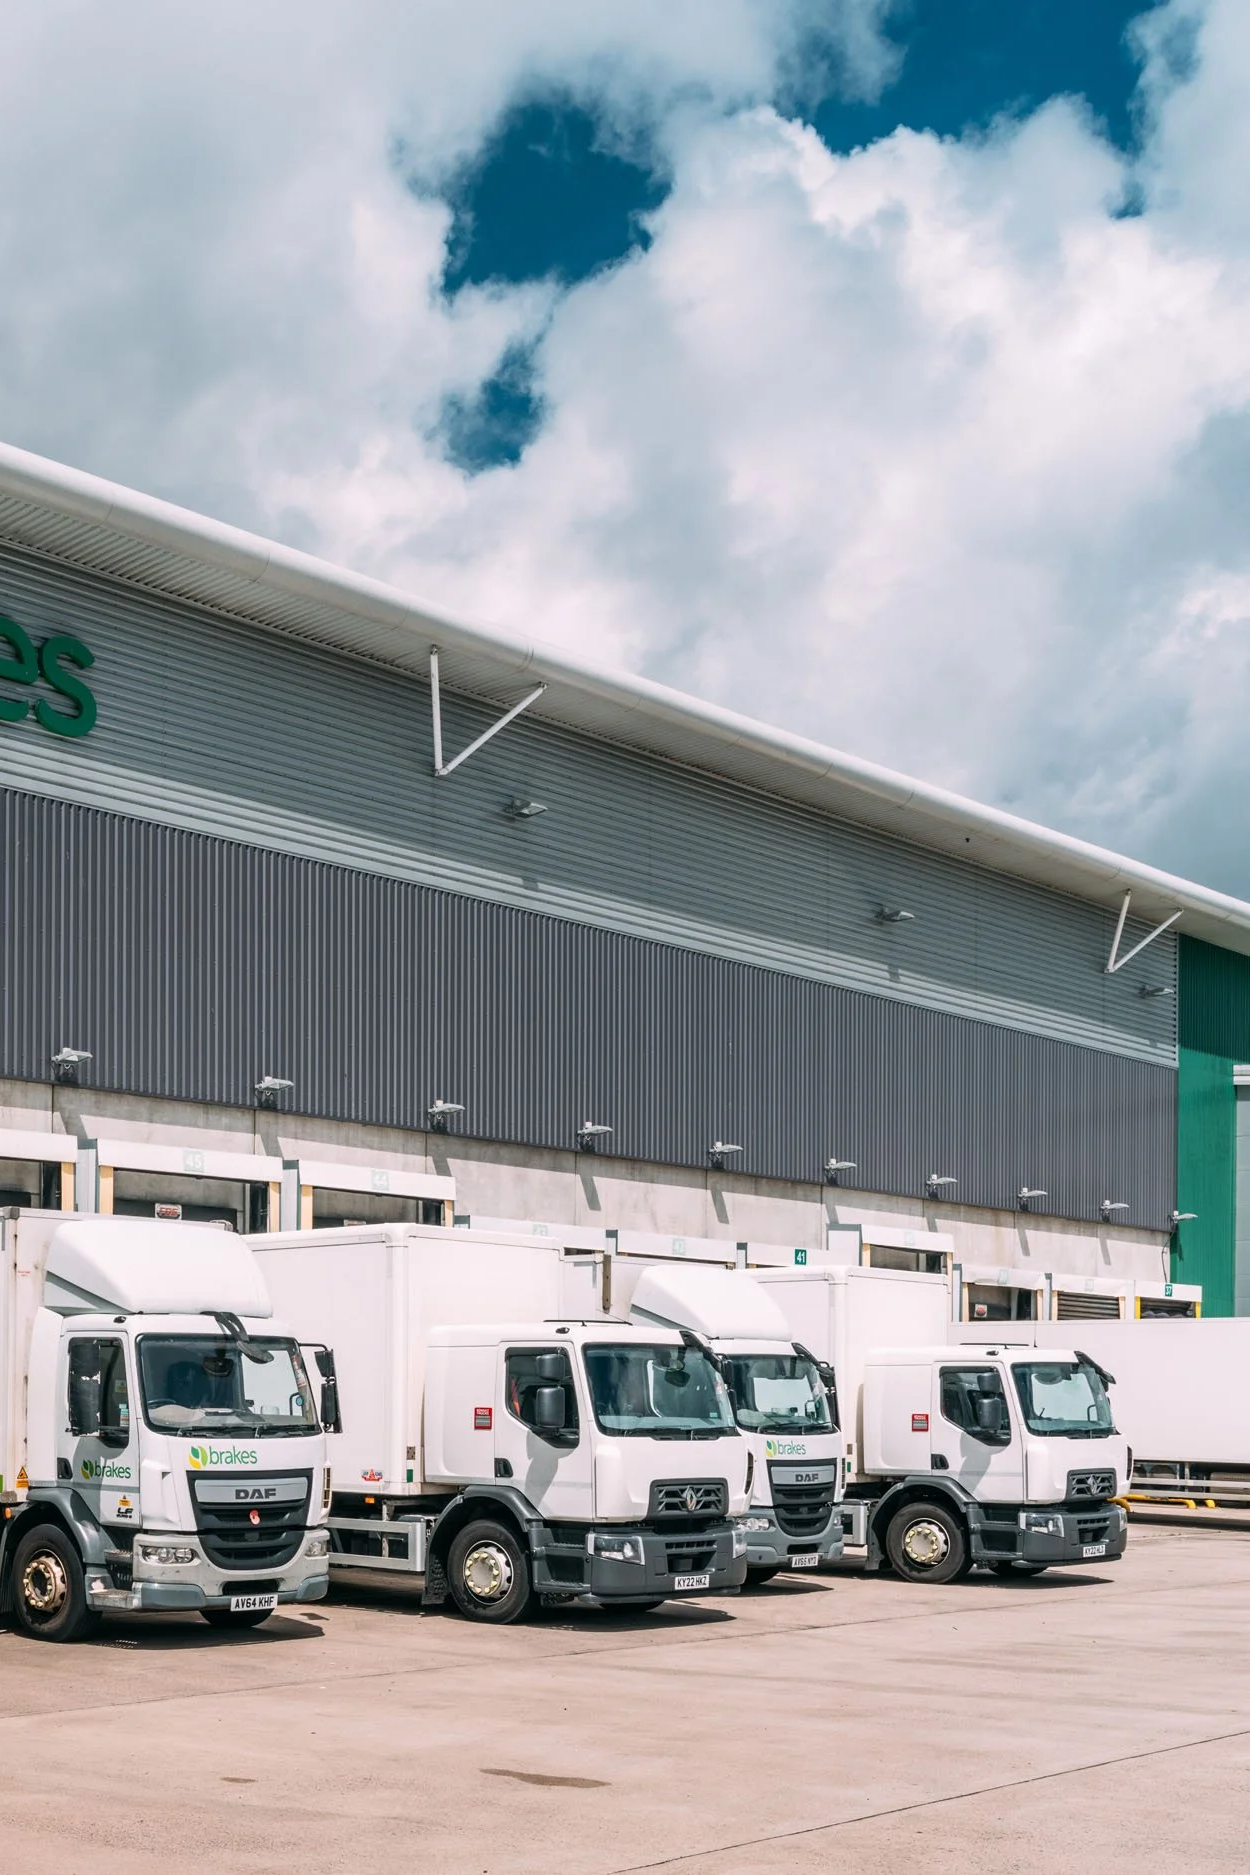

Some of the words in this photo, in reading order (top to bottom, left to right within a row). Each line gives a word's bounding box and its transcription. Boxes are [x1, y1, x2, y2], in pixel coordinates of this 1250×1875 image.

[185, 1153, 202, 1169] 45
[796, 1251, 806, 1264] 41
[777, 1440, 807, 1455] brakes
[209, 1445, 258, 1465] brakes
[94, 1461, 131, 1479] brakes
[795, 1473, 819, 1483] DAF
[235, 1488, 277, 1500] DAF
[677, 1577, 695, 1588] KY22
[695, 1576, 707, 1586] HKZ
[235, 1597, 257, 1609] AV64
[258, 1596, 275, 1608] KHF
